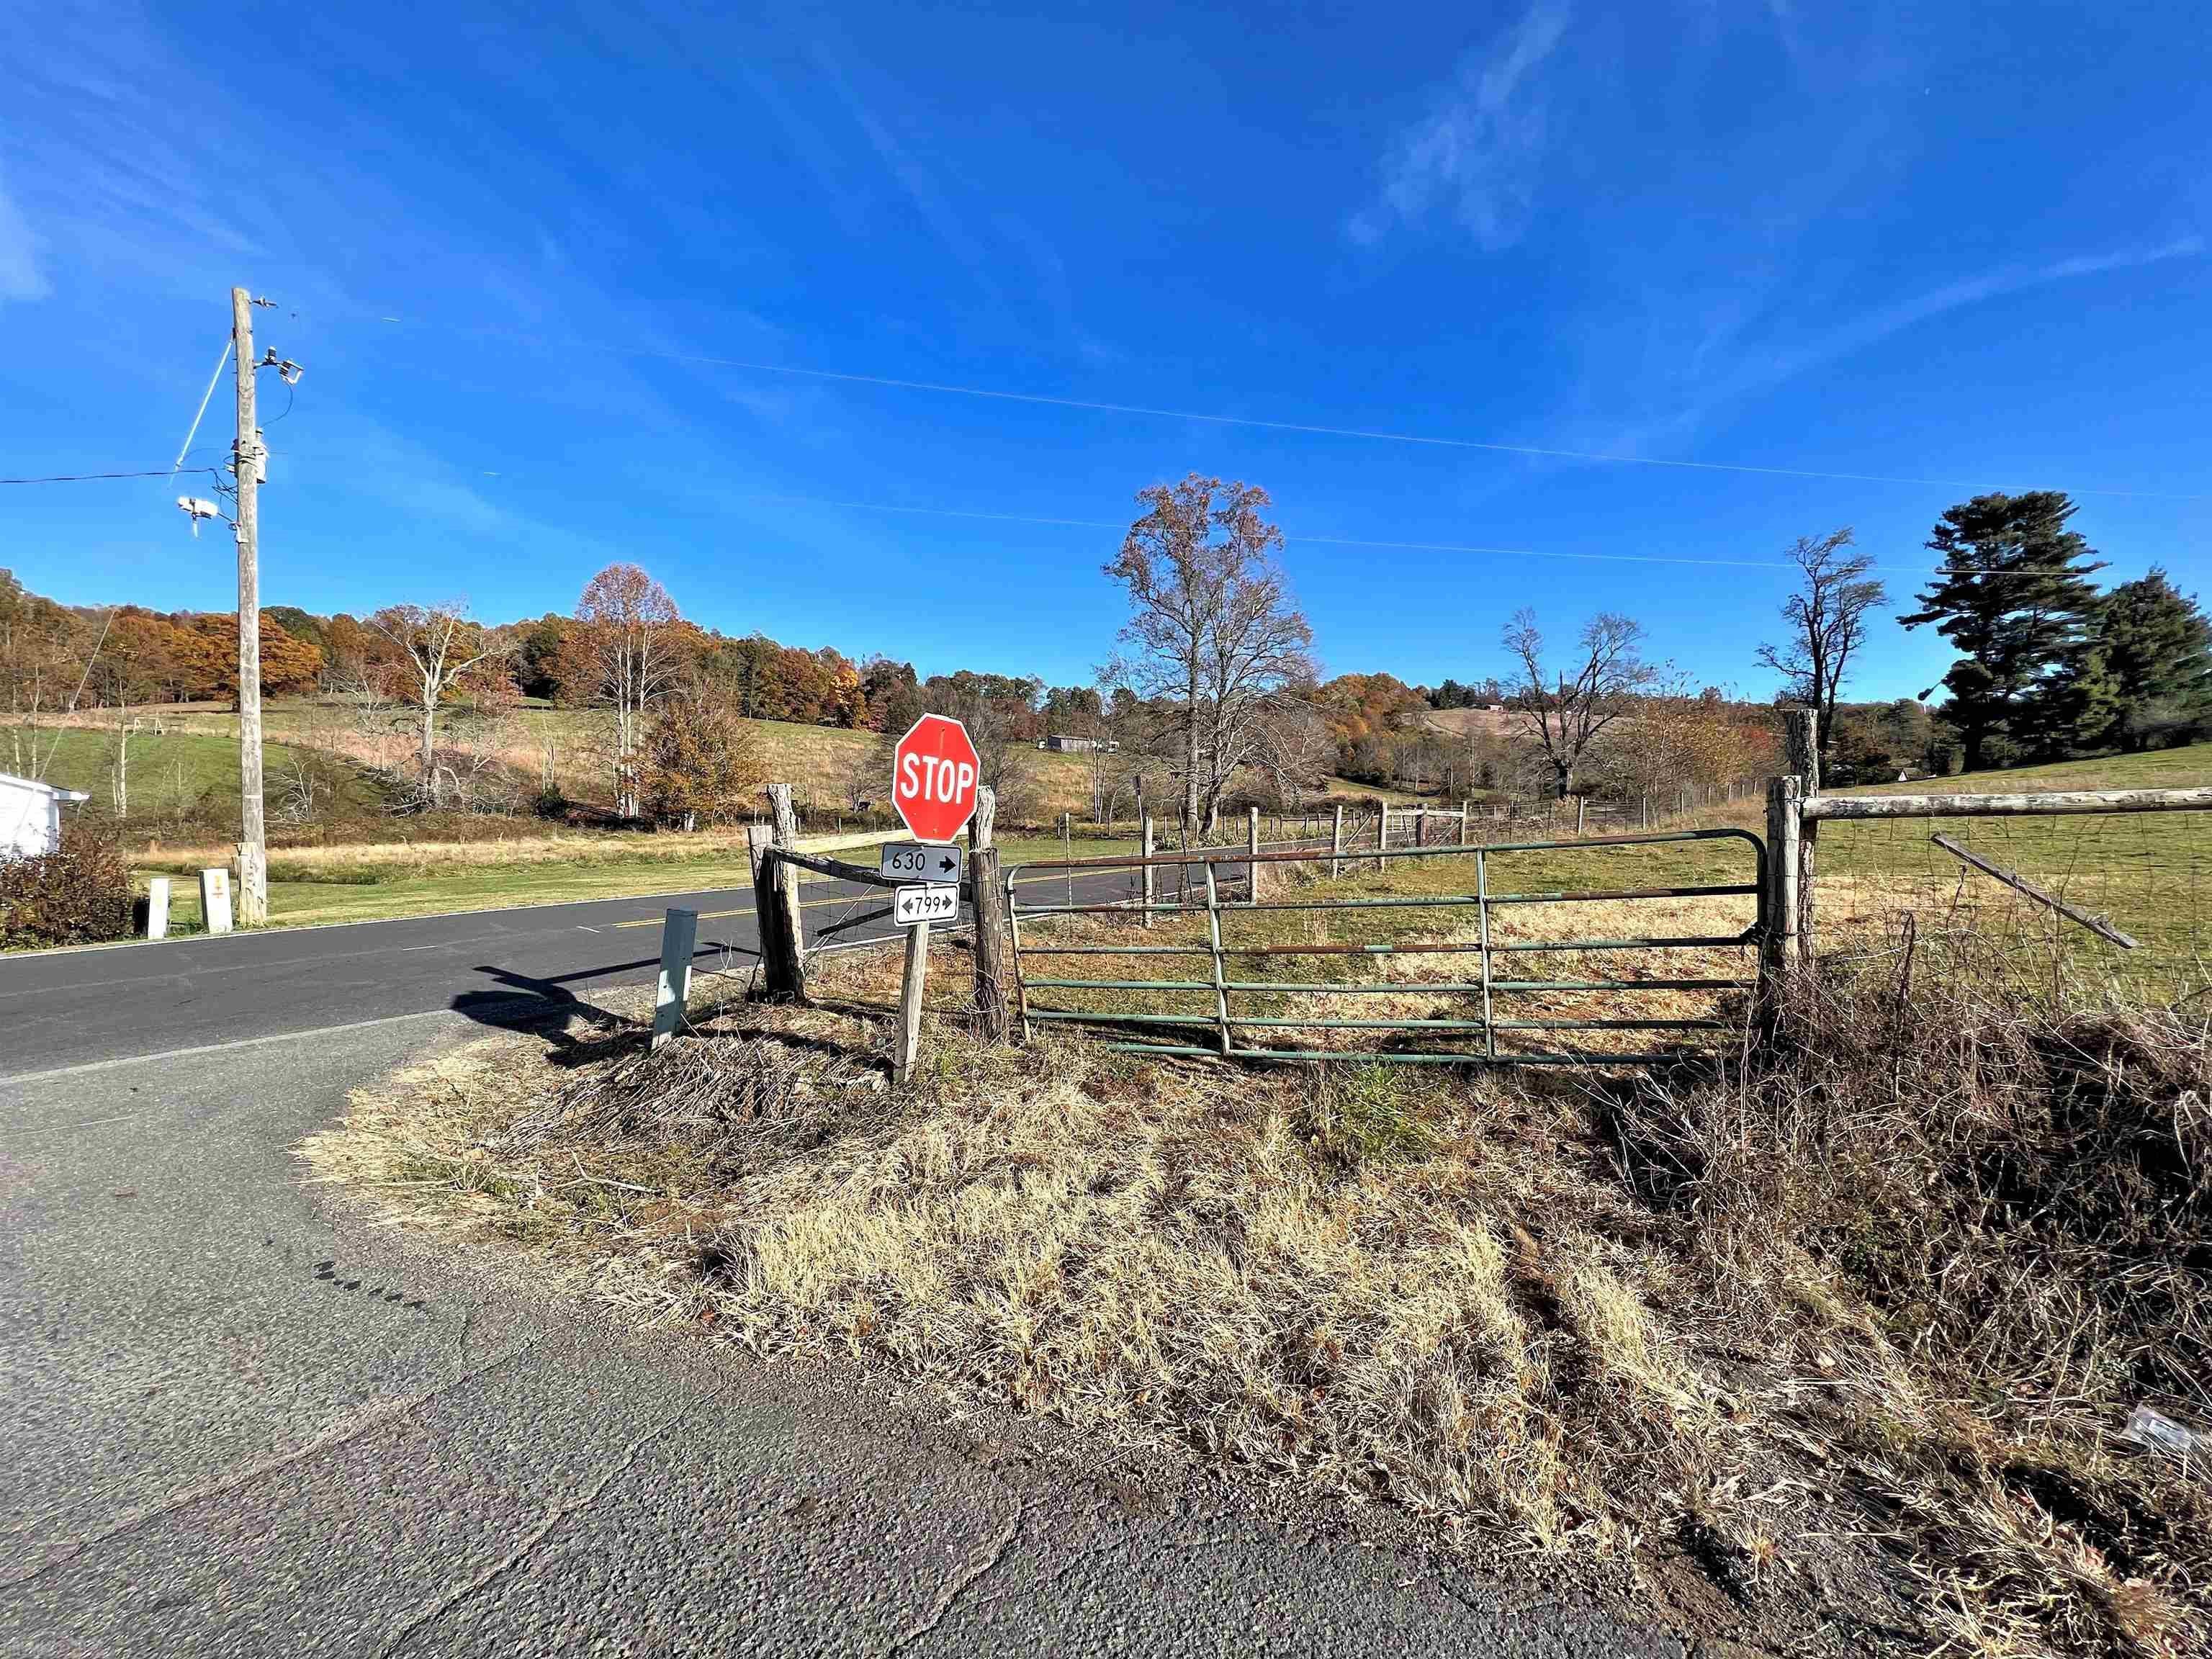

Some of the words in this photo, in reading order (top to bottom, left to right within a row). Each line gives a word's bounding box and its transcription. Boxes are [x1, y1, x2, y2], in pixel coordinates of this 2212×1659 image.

[900, 752, 974, 804] STOP
[891, 852, 926, 871] 630
[915, 896, 940, 914] 799
